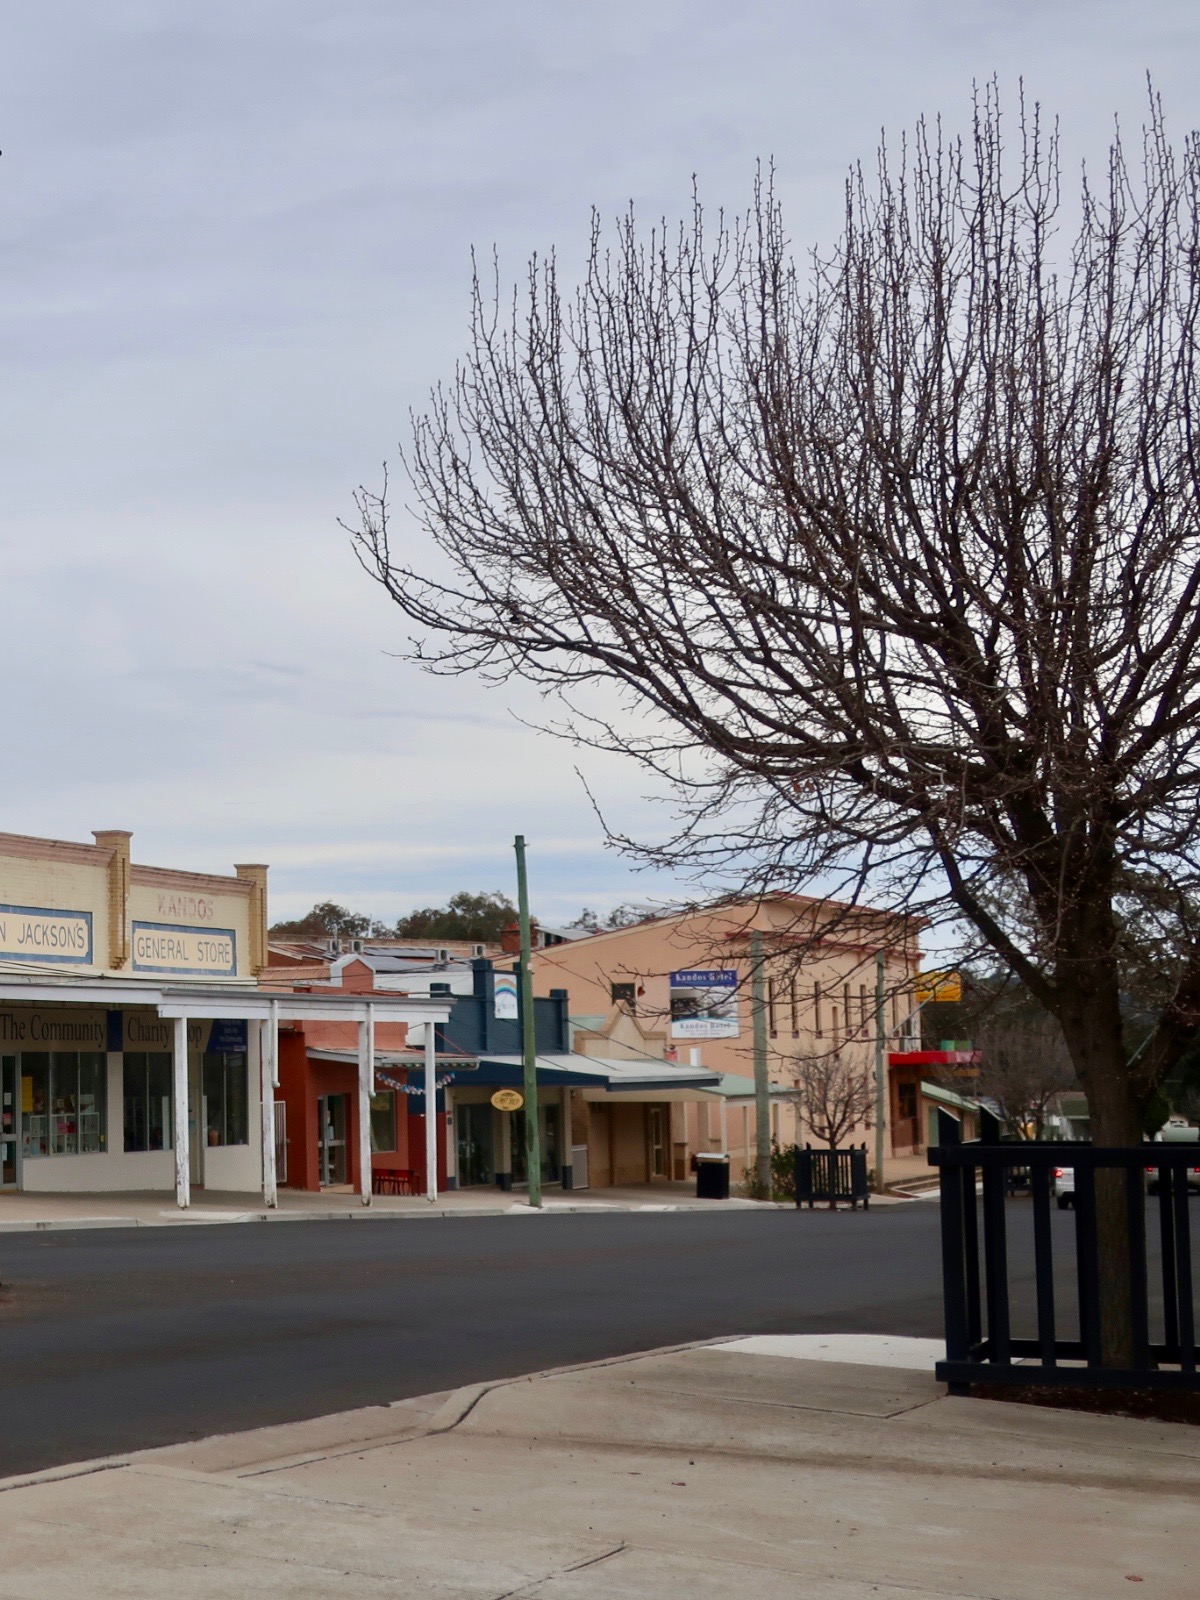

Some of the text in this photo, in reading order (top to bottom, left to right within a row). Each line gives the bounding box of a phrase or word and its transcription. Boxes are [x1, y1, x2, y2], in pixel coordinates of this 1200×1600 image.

[17, 922, 85, 949] JACKSON'S
[137, 936, 231, 964] GENERAL STORE
[675, 973, 707, 981] Kandos
[0, 1013, 26, 1040] The
[30, 1014, 104, 1048] Community
[127, 1017, 171, 1049] Charity
